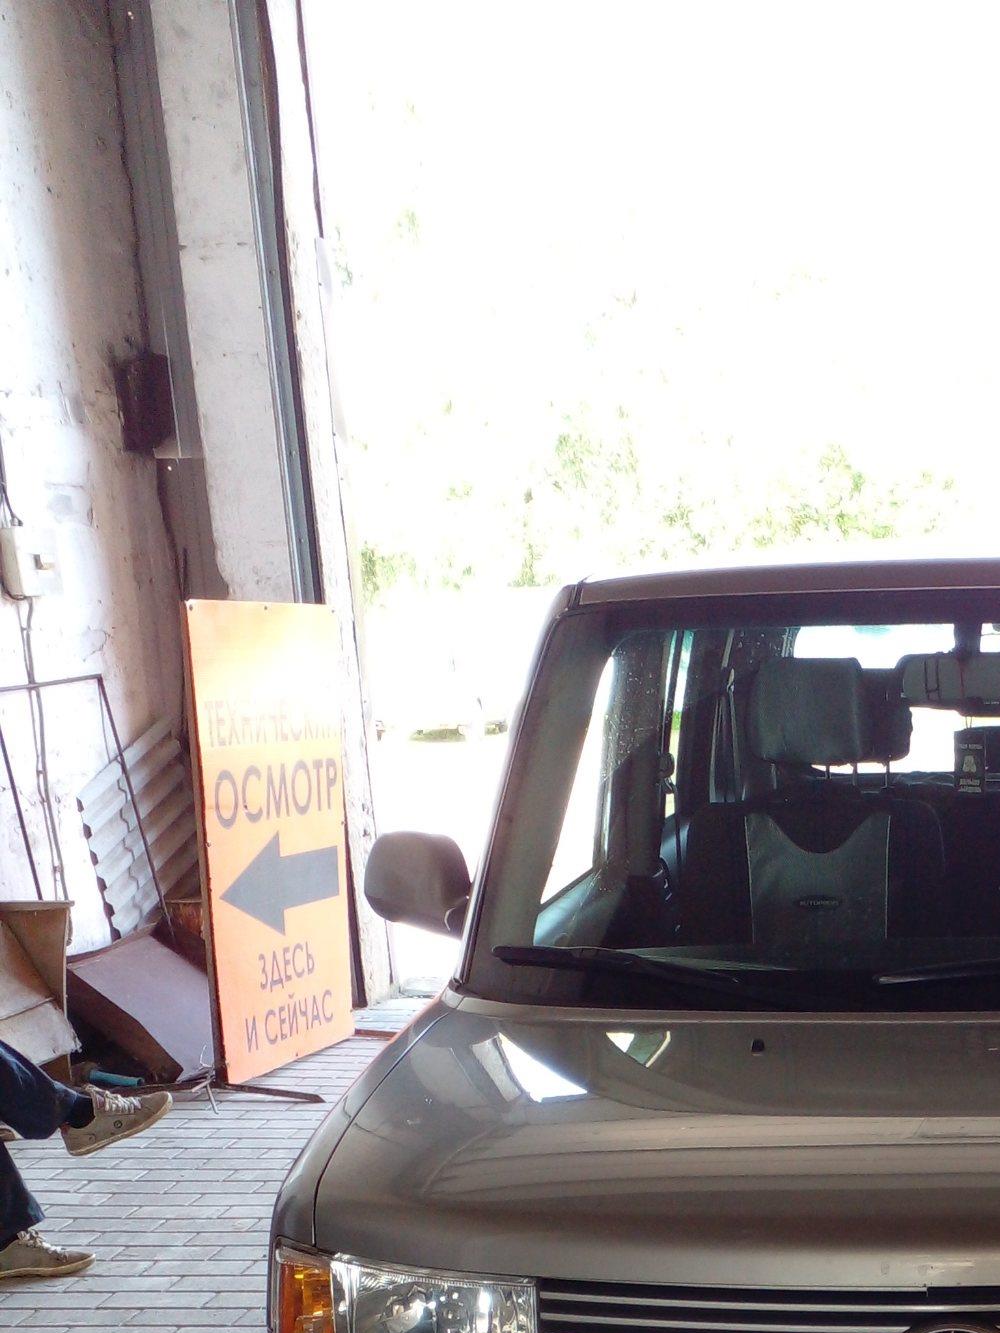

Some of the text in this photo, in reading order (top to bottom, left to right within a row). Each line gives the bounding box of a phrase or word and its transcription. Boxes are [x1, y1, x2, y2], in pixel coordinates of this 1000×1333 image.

[214, 757, 338, 830] ОСМОТР
[258, 940, 315, 993] ЗДЕСЬ
[244, 989, 334, 1054] И СЕЙЧАС
